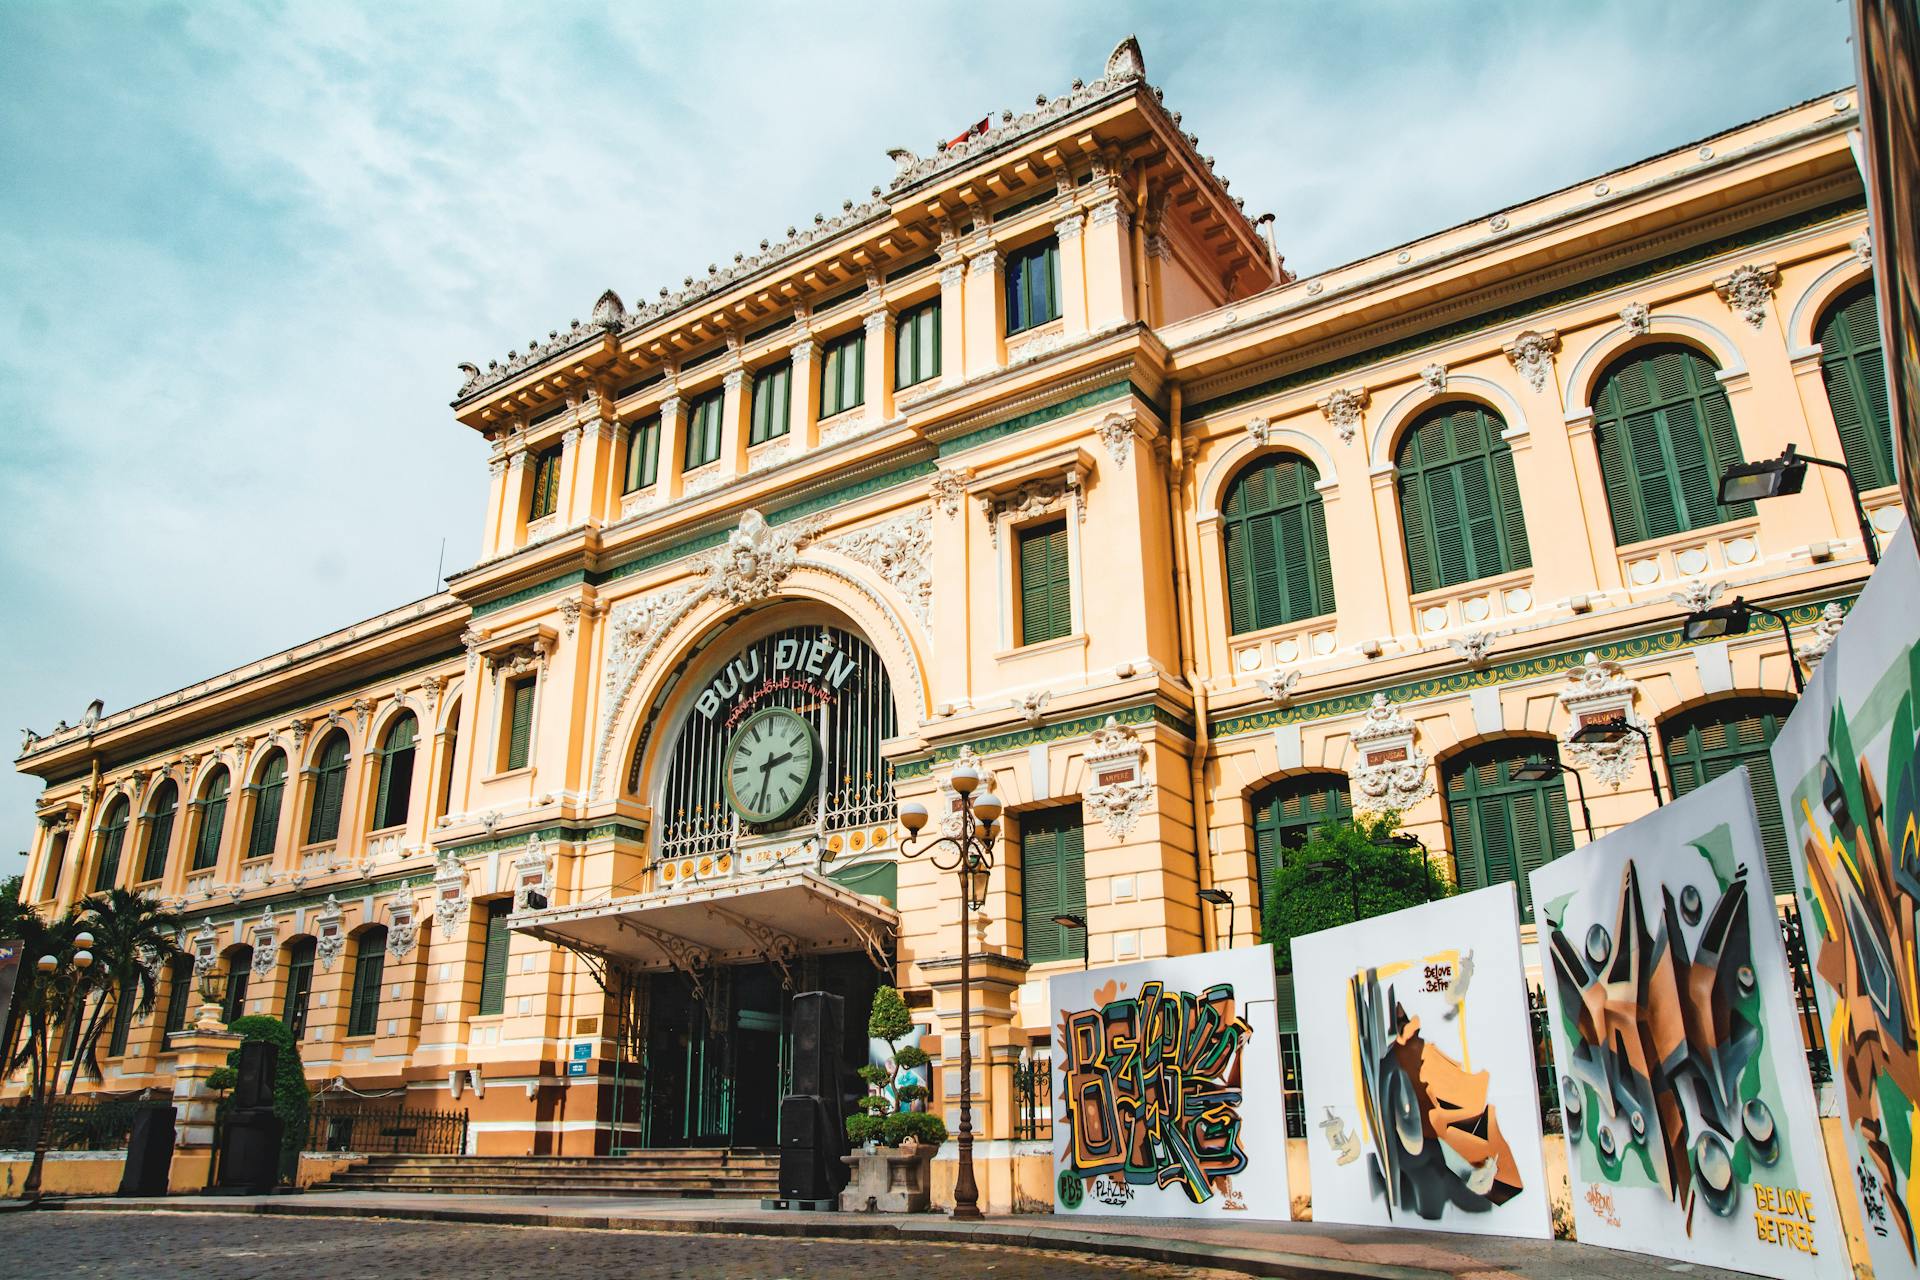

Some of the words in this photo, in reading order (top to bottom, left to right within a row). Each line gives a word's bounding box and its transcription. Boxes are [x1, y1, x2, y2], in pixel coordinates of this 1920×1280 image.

[776, 633, 857, 689] ĐIỆN
[1753, 1183, 1775, 1211] BE
[1776, 1186, 1816, 1223] LOVE
[1753, 1211, 1777, 1243] BE
[1774, 1216, 1819, 1255] FREE
